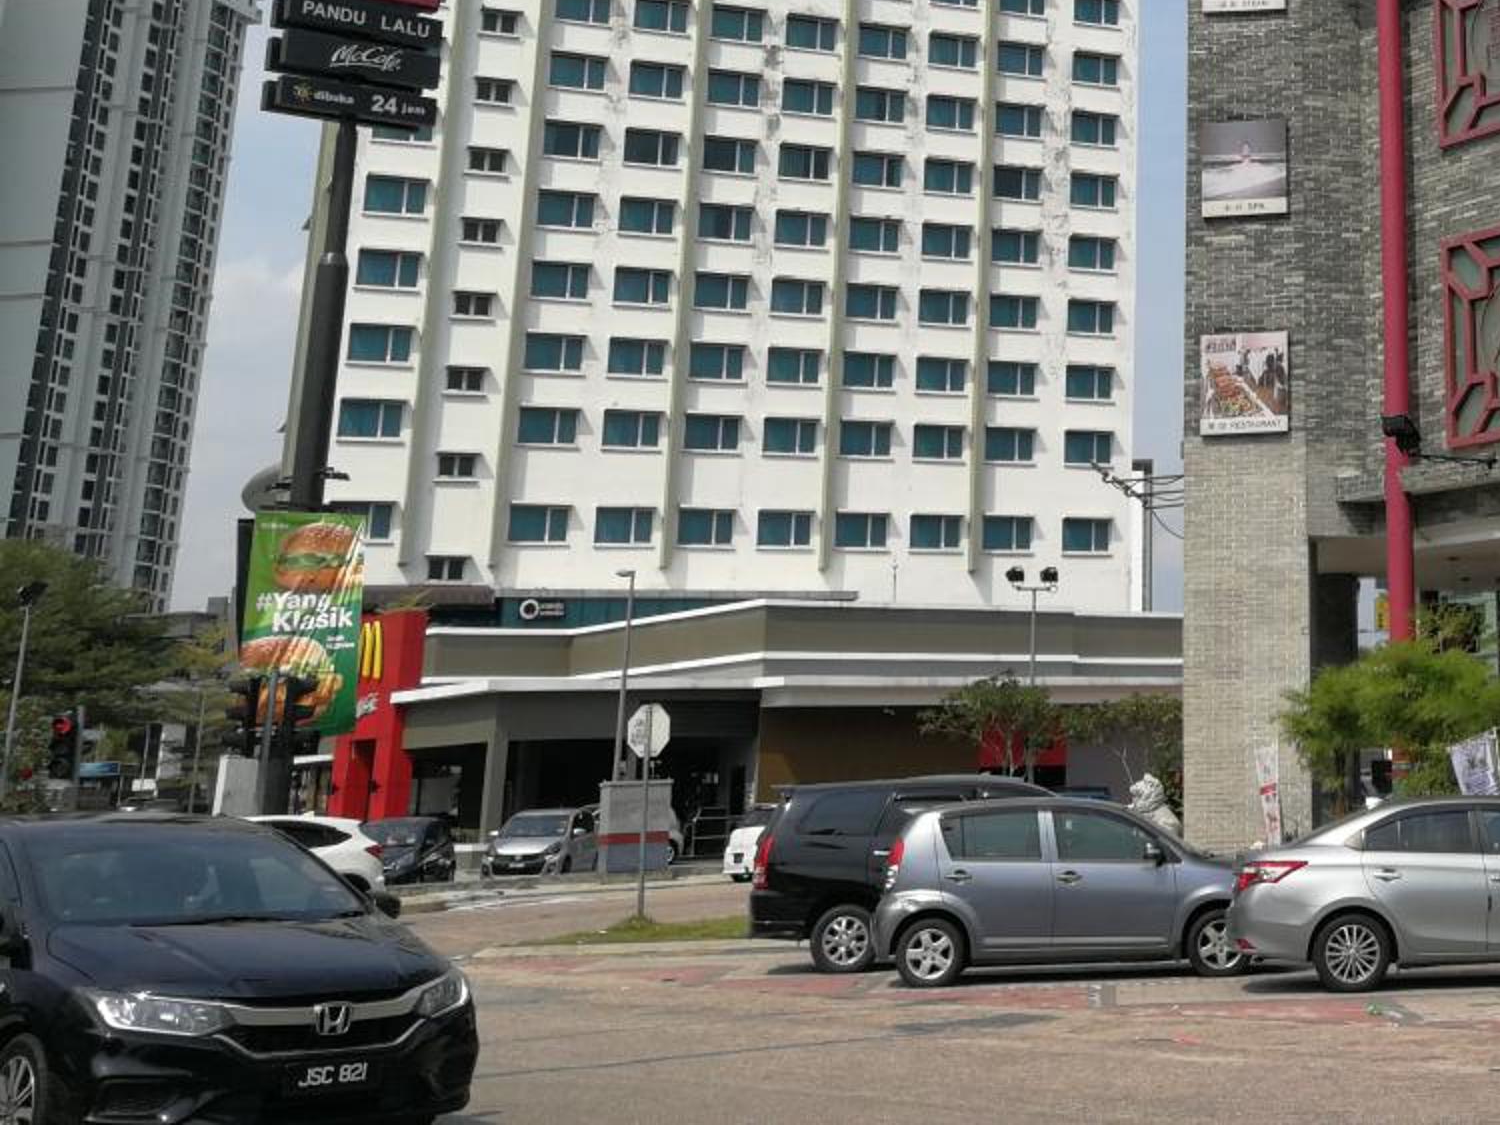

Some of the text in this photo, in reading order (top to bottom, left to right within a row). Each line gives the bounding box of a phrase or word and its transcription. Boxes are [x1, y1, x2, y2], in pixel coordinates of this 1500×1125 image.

[303, 0, 430, 38] PANDU LALU
[371, 94, 398, 115] 24
[256, 590, 328, 615] #Yang
[272, 605, 353, 633] Klasik
[298, 1062, 369, 1087] JSC 821
